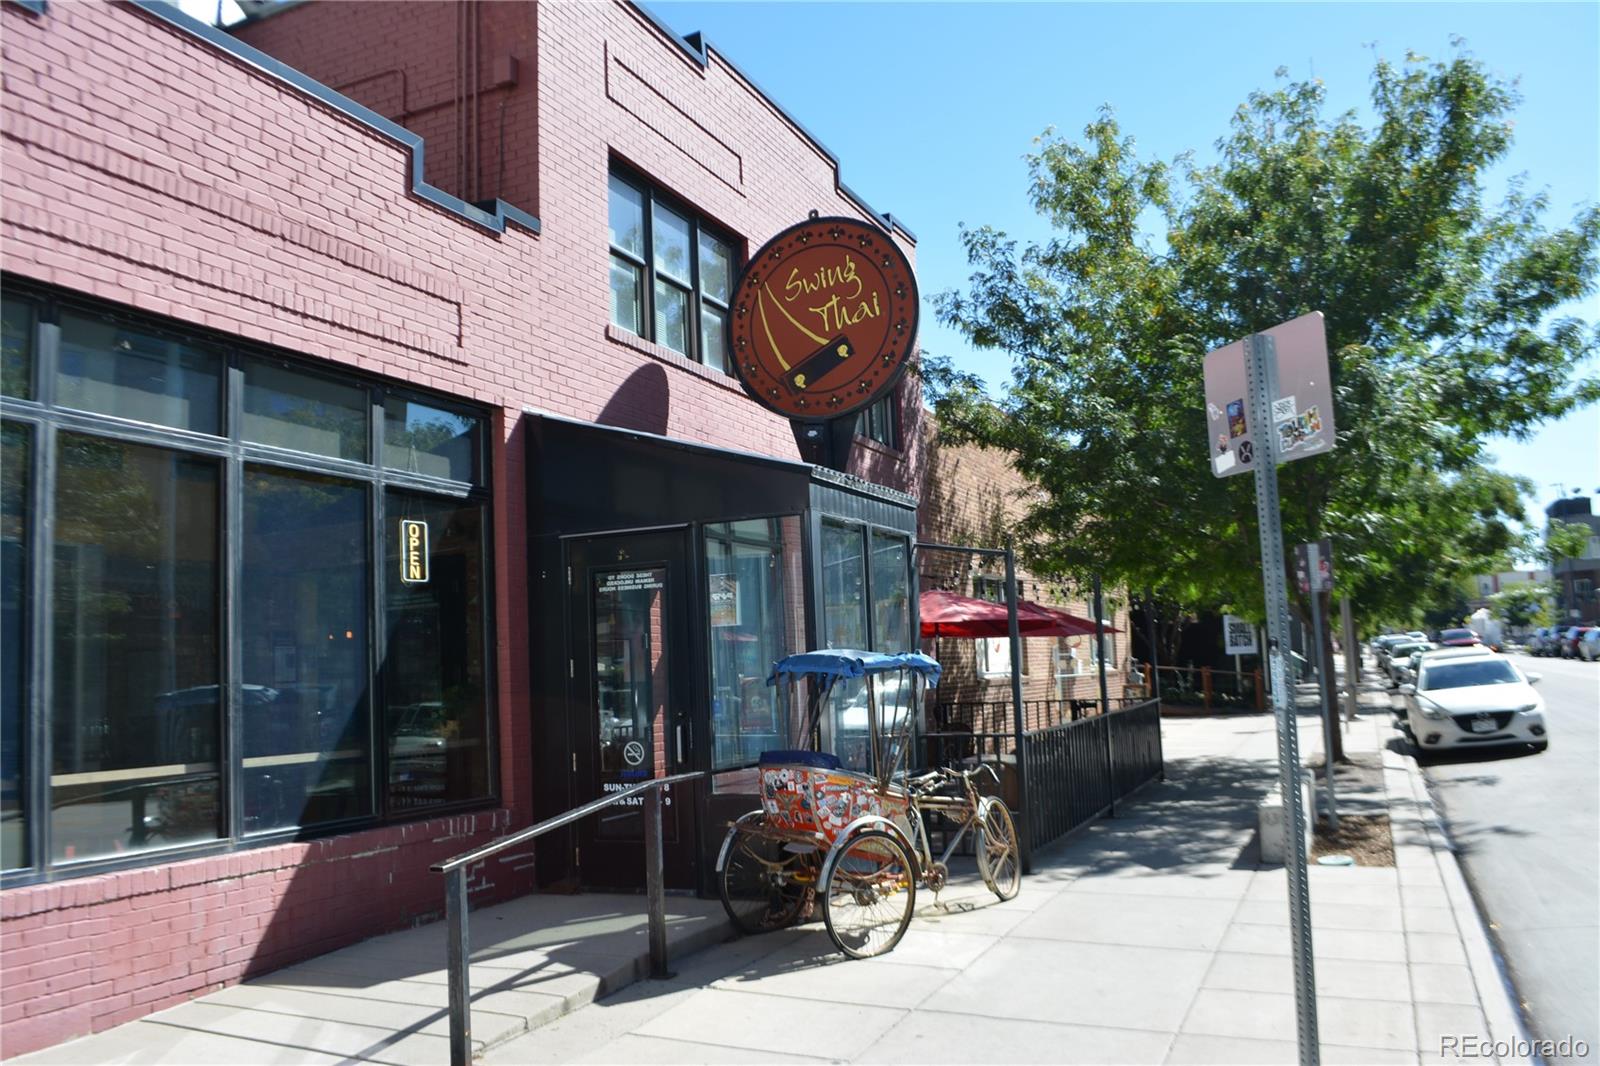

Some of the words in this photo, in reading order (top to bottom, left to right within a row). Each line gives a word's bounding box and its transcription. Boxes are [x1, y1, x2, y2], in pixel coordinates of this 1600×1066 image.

[784, 254, 863, 302] Swing
[809, 291, 881, 332] Thai
[408, 523, 421, 579] OPEN
